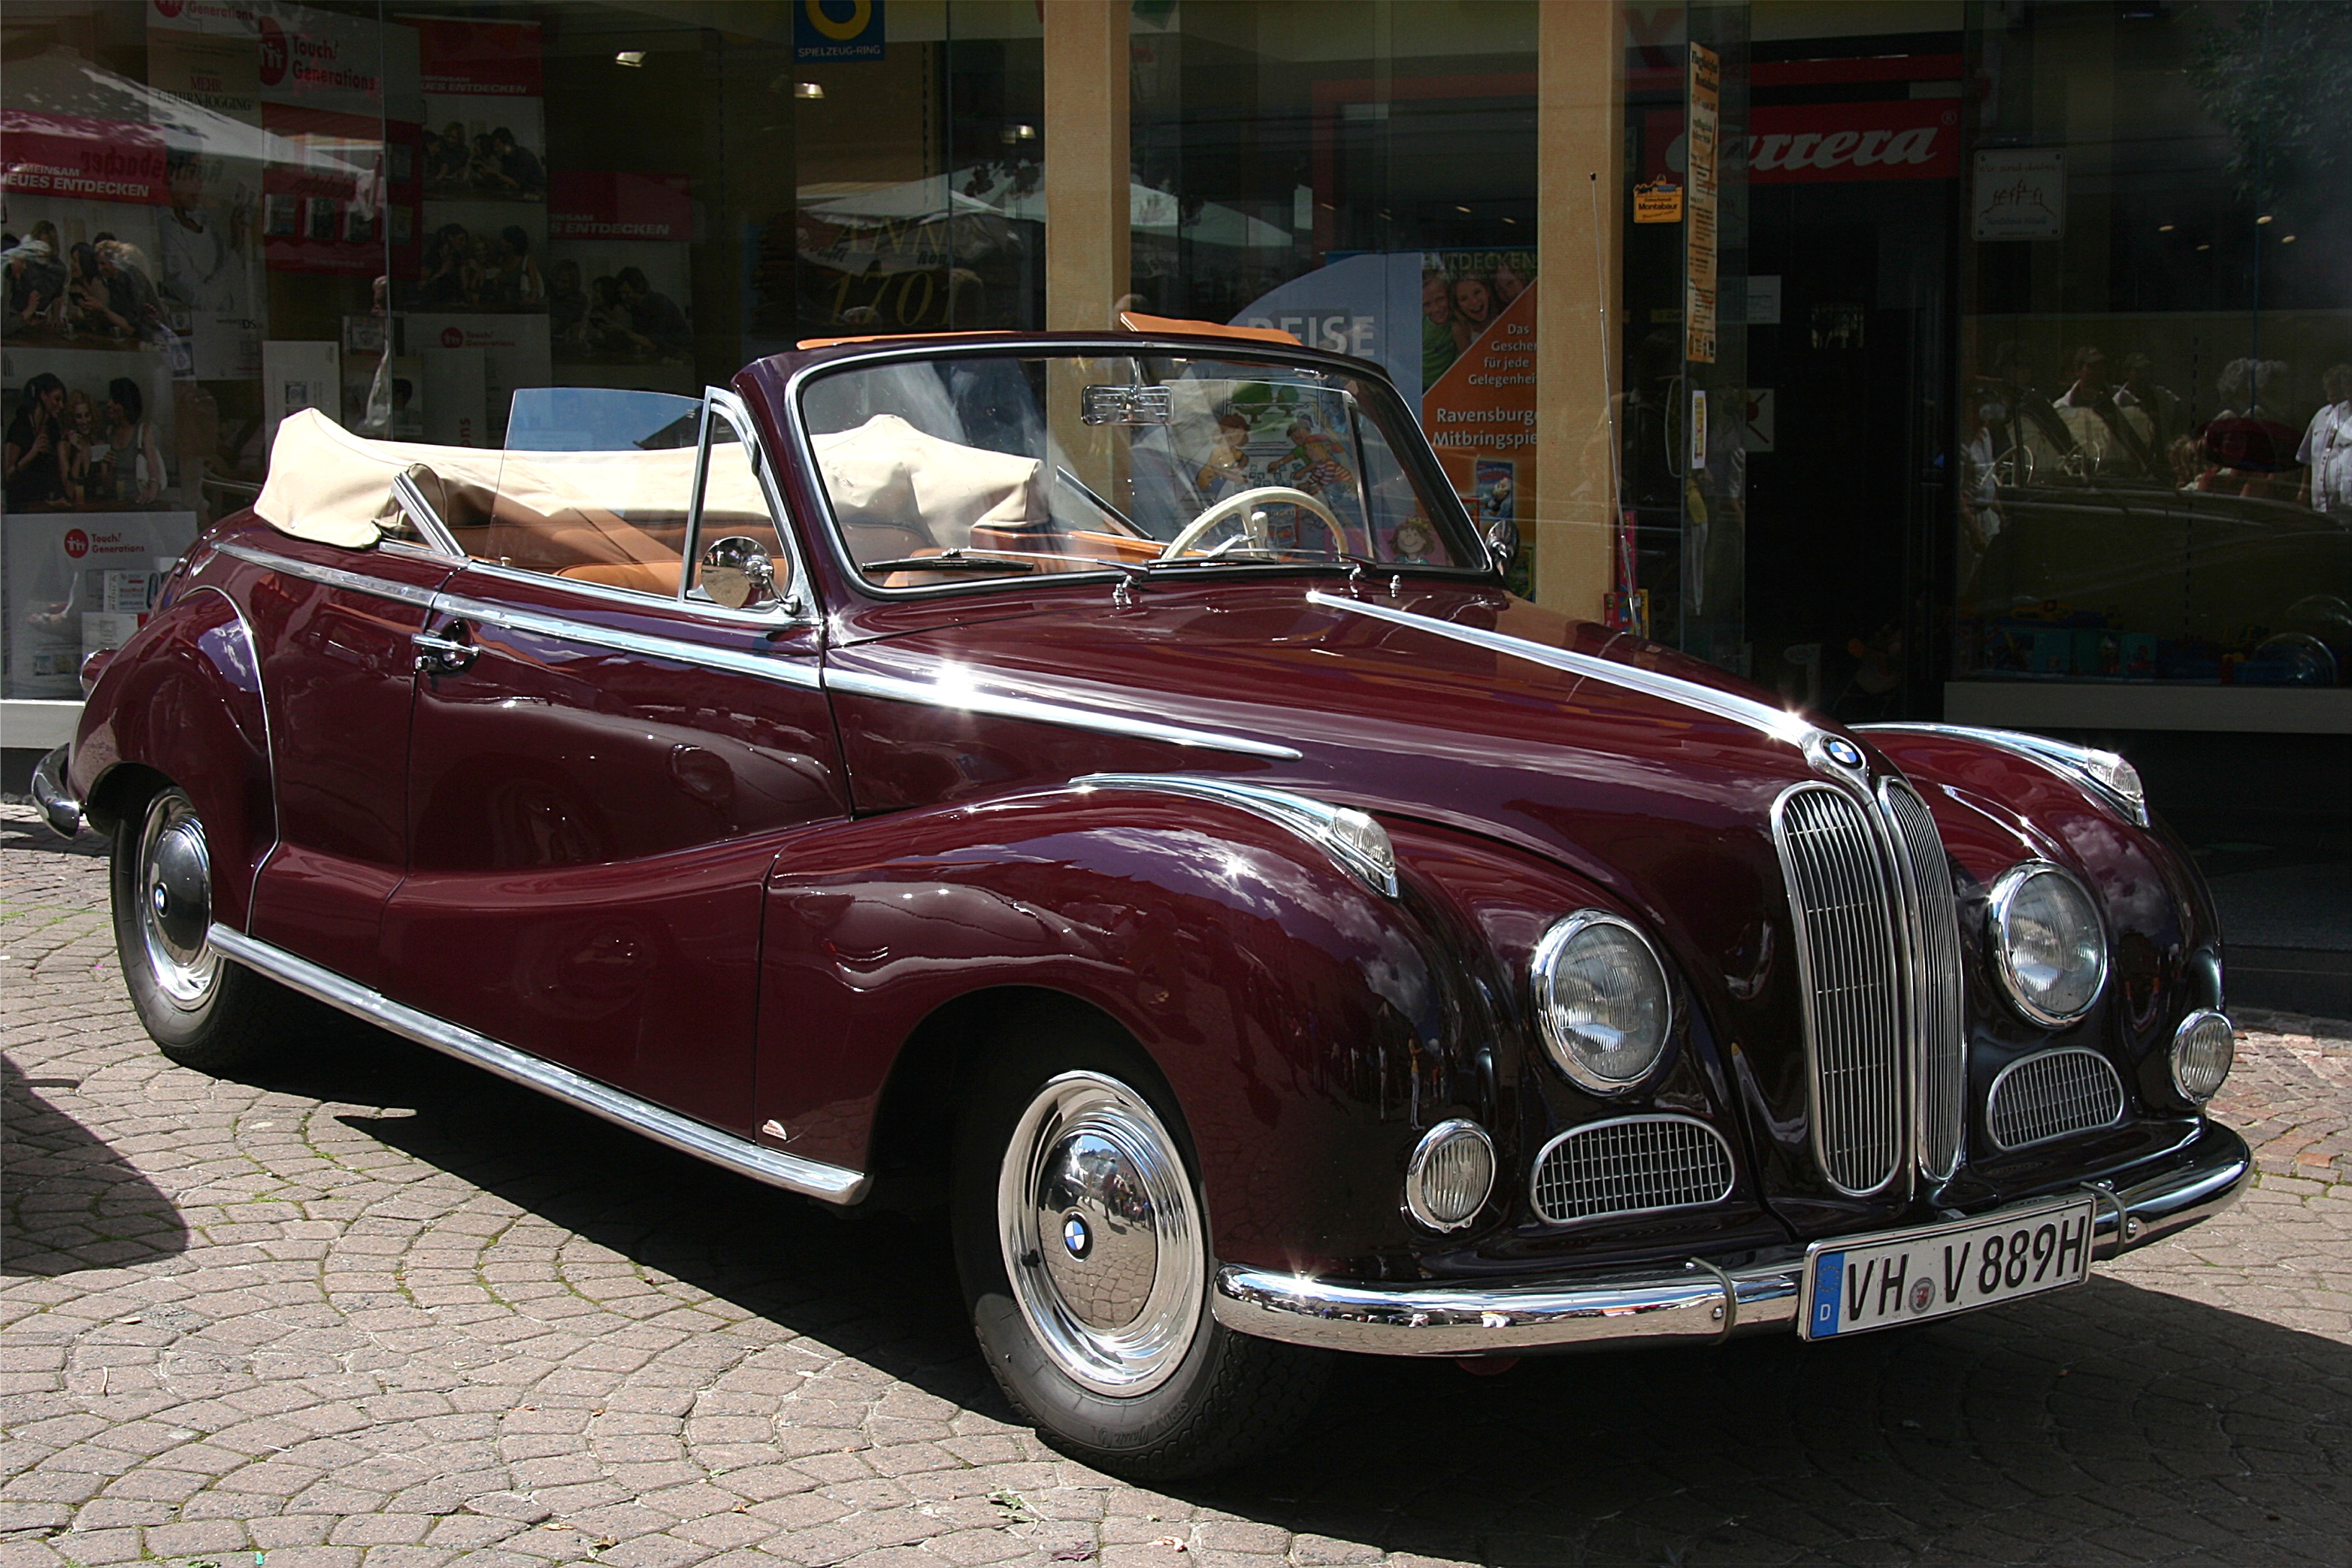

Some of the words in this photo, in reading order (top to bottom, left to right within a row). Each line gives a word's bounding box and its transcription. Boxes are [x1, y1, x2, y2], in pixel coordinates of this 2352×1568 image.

[189, 5, 254, 21] Generations
[292, 35, 338, 61] Touch!
[798, 45, 881, 58] SPIELZEUG-RING
[292, 60, 376, 92] Generations
[189, 76, 223, 93] MEHR
[448, 83, 527, 94] ENTDECKEN
[53, 177, 150, 198] ENTDECKEN
[565, 223, 670, 235] ENTDECKEN
[1421, 251, 1536, 271] ENTDECKEN
[1507, 323, 1530, 335] Das
[1483, 356, 1502, 368] für
[1503, 356, 1530, 371] jede
[1468, 373, 1537, 389] Gelegenhei
[91, 531, 122, 543] Touch!
[91, 543, 145, 554] Generations
[1848, 1253, 1909, 1321] VH
[1944, 1241, 1971, 1303] V
[1978, 1215, 2087, 1294] 889H
[1819, 1303, 1831, 1322] D
